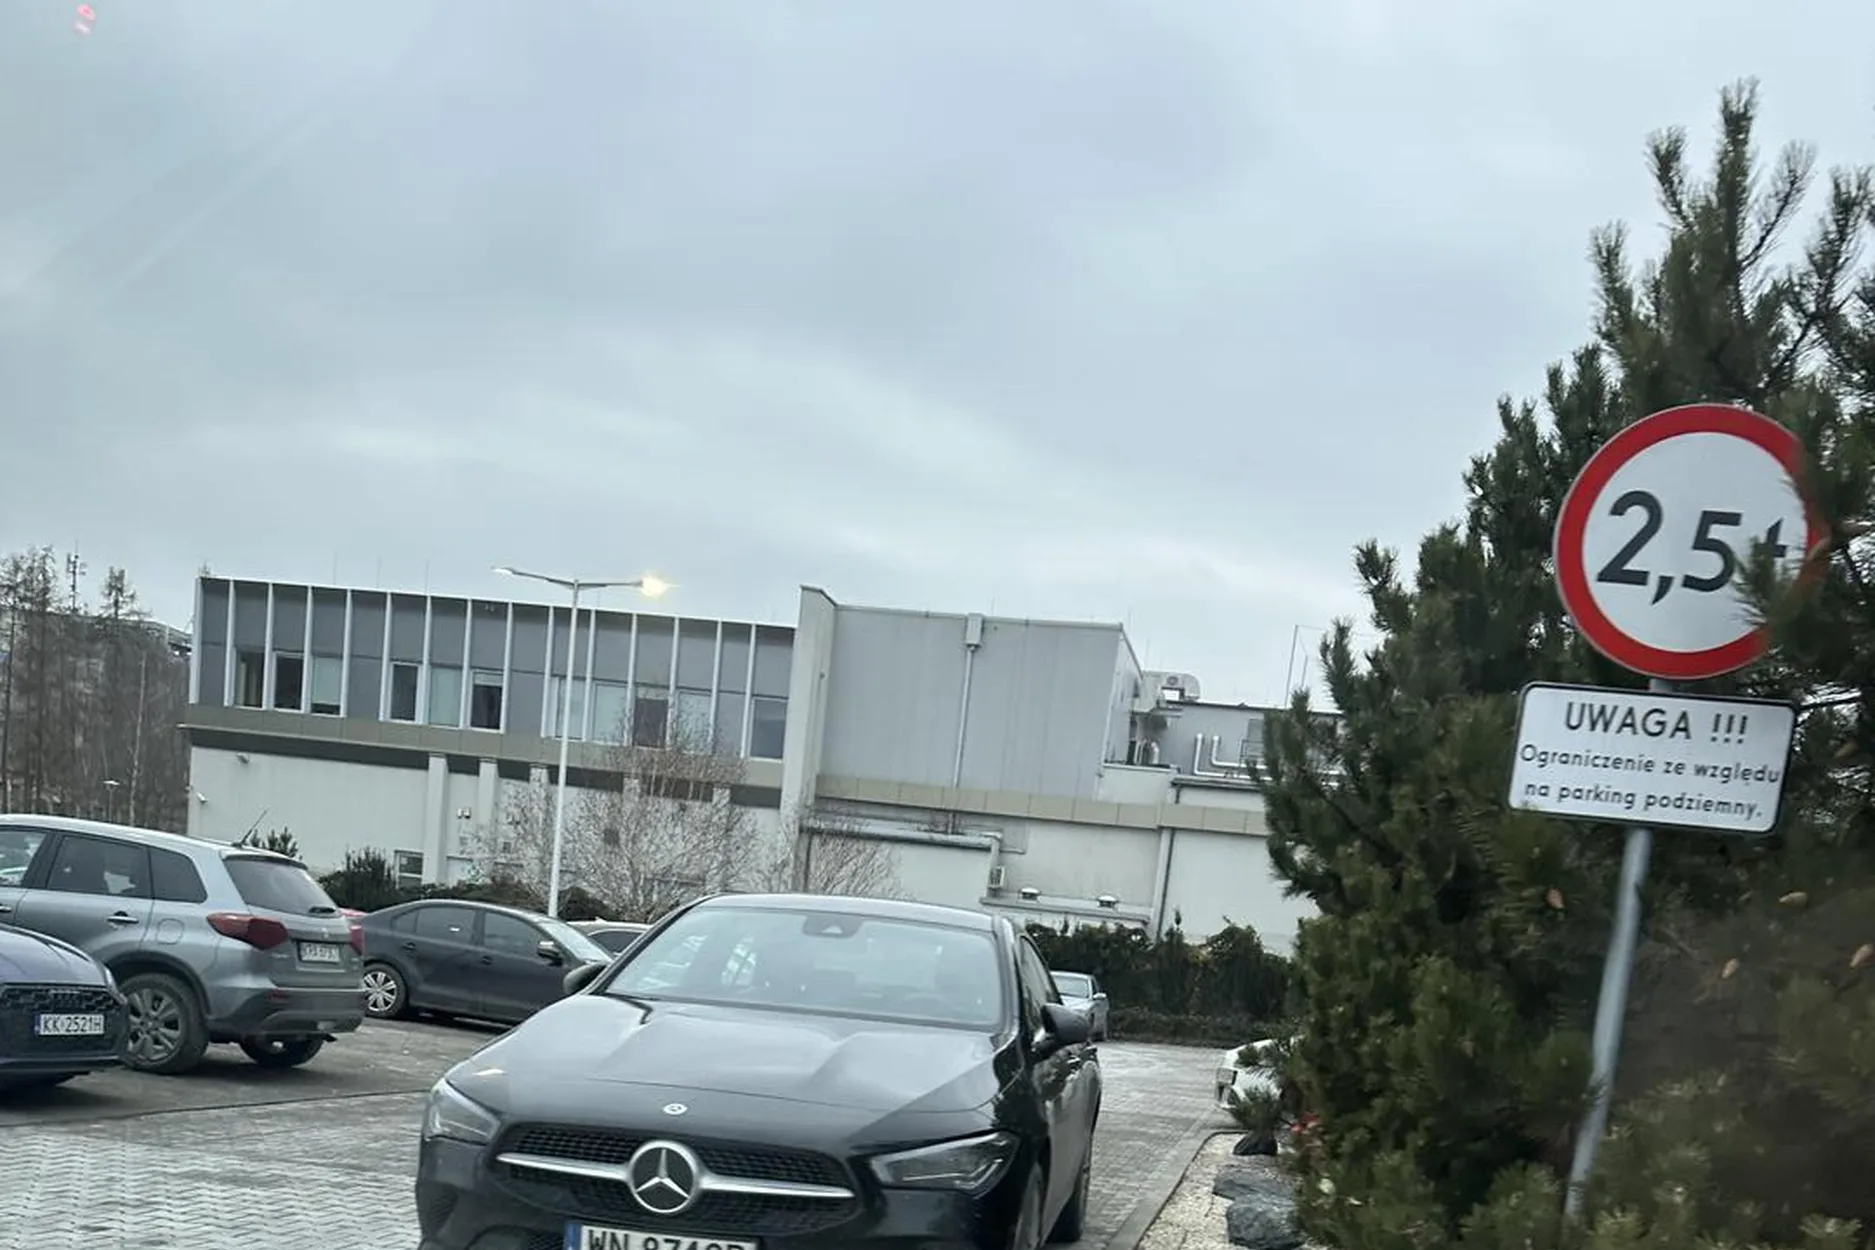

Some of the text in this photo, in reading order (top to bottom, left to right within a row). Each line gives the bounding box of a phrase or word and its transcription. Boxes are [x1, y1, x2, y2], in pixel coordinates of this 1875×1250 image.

[1565, 702, 1748, 744] UWAGA !!!
[1520, 744, 1780, 788] Ograniczenie ze względu
[1524, 783, 1762, 821] na parking podziemny.
[43, 1015, 60, 1033] KK
